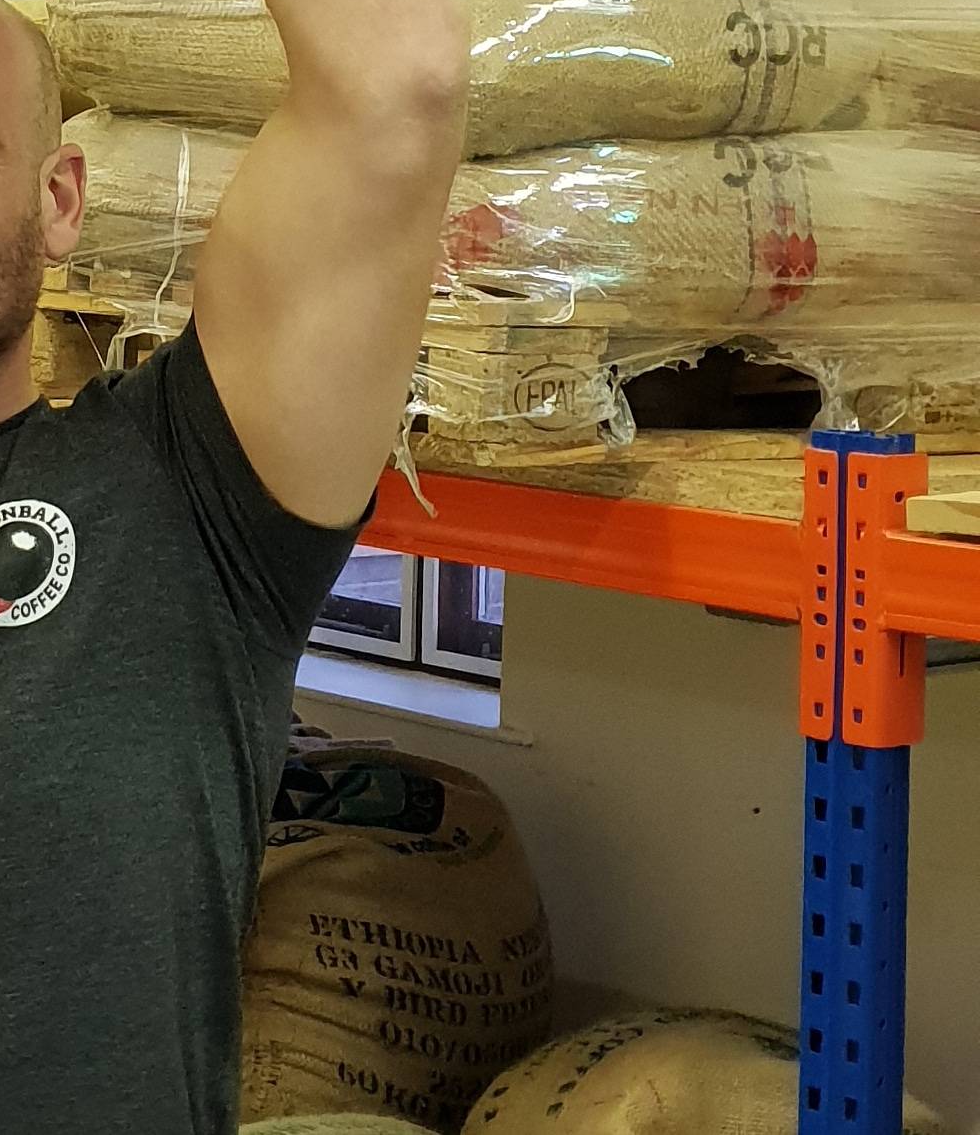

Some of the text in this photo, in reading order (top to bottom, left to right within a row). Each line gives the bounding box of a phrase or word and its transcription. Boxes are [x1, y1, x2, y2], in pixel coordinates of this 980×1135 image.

[11, 577, 63, 621] COFFEE
[308, 913, 483, 966] ETHIOPIA
[385, 984, 469, 1028] BIRD
